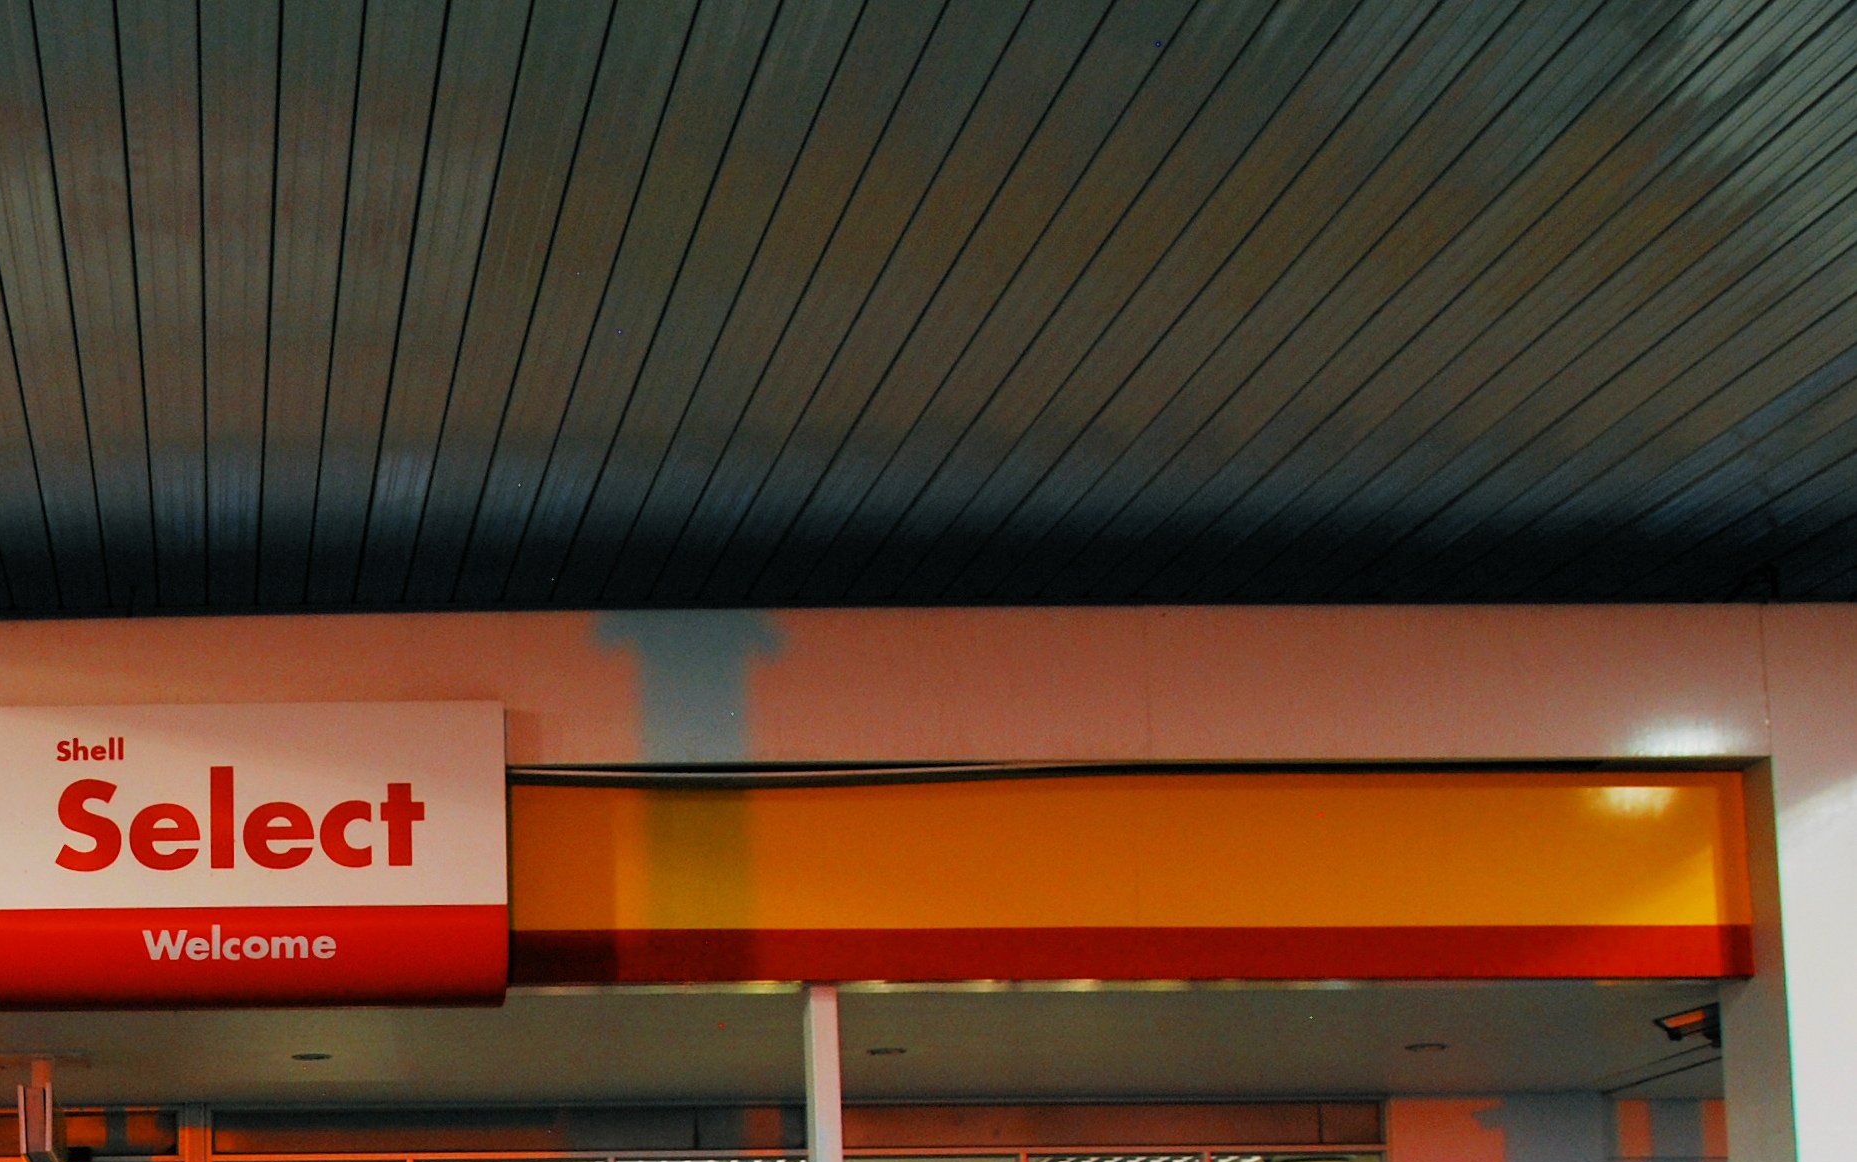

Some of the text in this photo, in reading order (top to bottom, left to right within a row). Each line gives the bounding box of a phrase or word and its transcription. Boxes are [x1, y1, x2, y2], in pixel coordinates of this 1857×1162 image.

[56, 737, 124, 761] Shell
[55, 766, 425, 872] Select
[143, 925, 336, 960] Welcome
